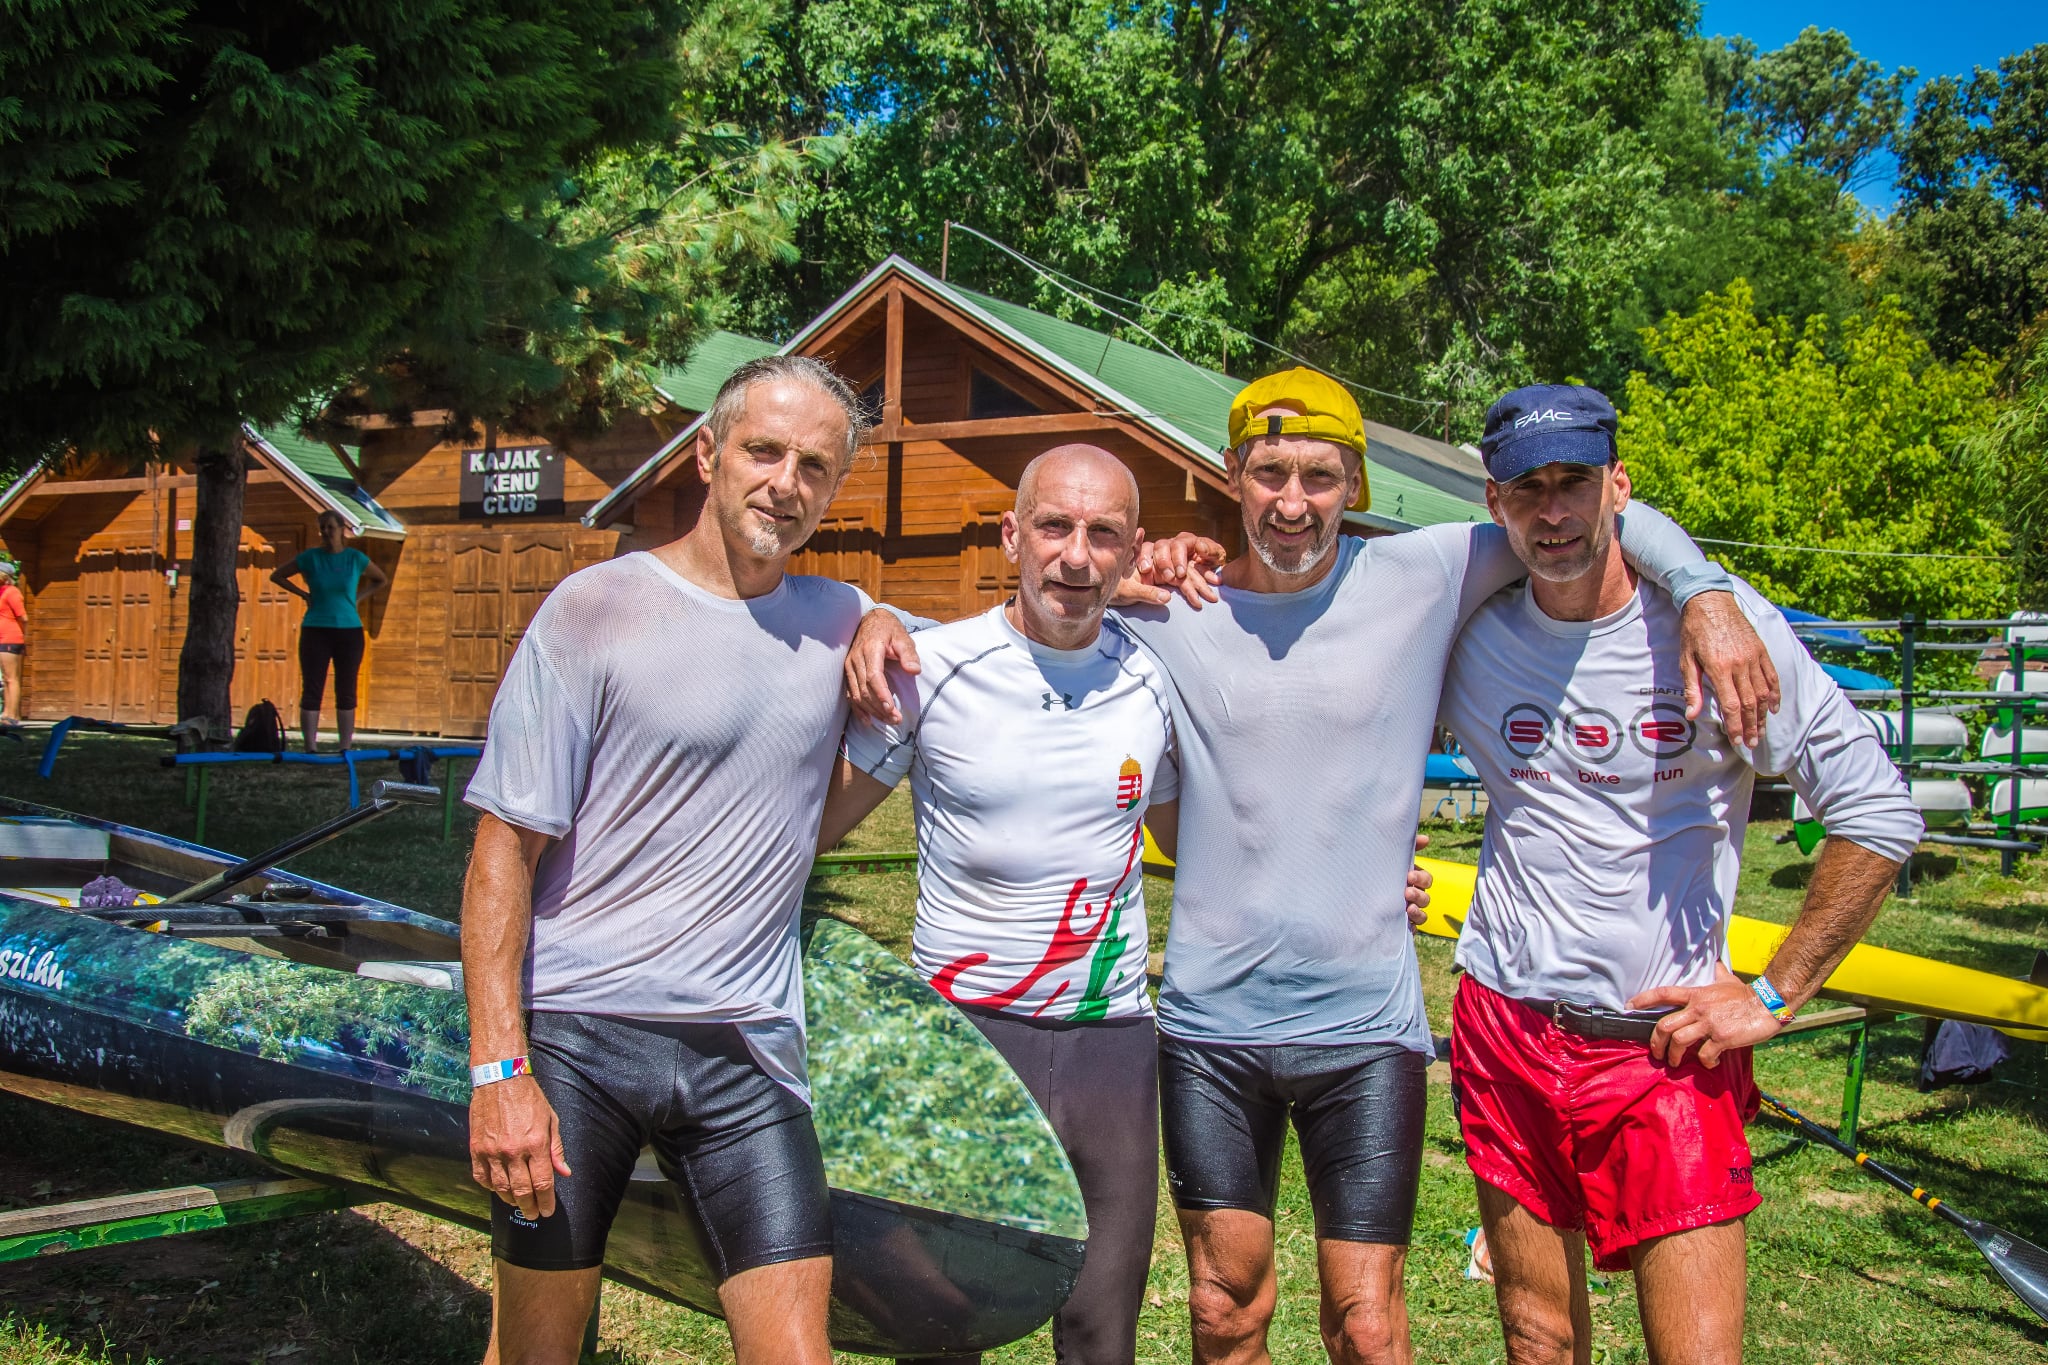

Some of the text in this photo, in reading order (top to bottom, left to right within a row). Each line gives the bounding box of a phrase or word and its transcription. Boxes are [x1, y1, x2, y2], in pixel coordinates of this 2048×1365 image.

[1514, 408, 1573, 429] FAAC
[469, 449, 541, 473] KAJAK
[484, 471, 540, 493] KENU
[482, 493, 538, 515] CLUB
[1509, 766, 1684, 785] swim bike run
